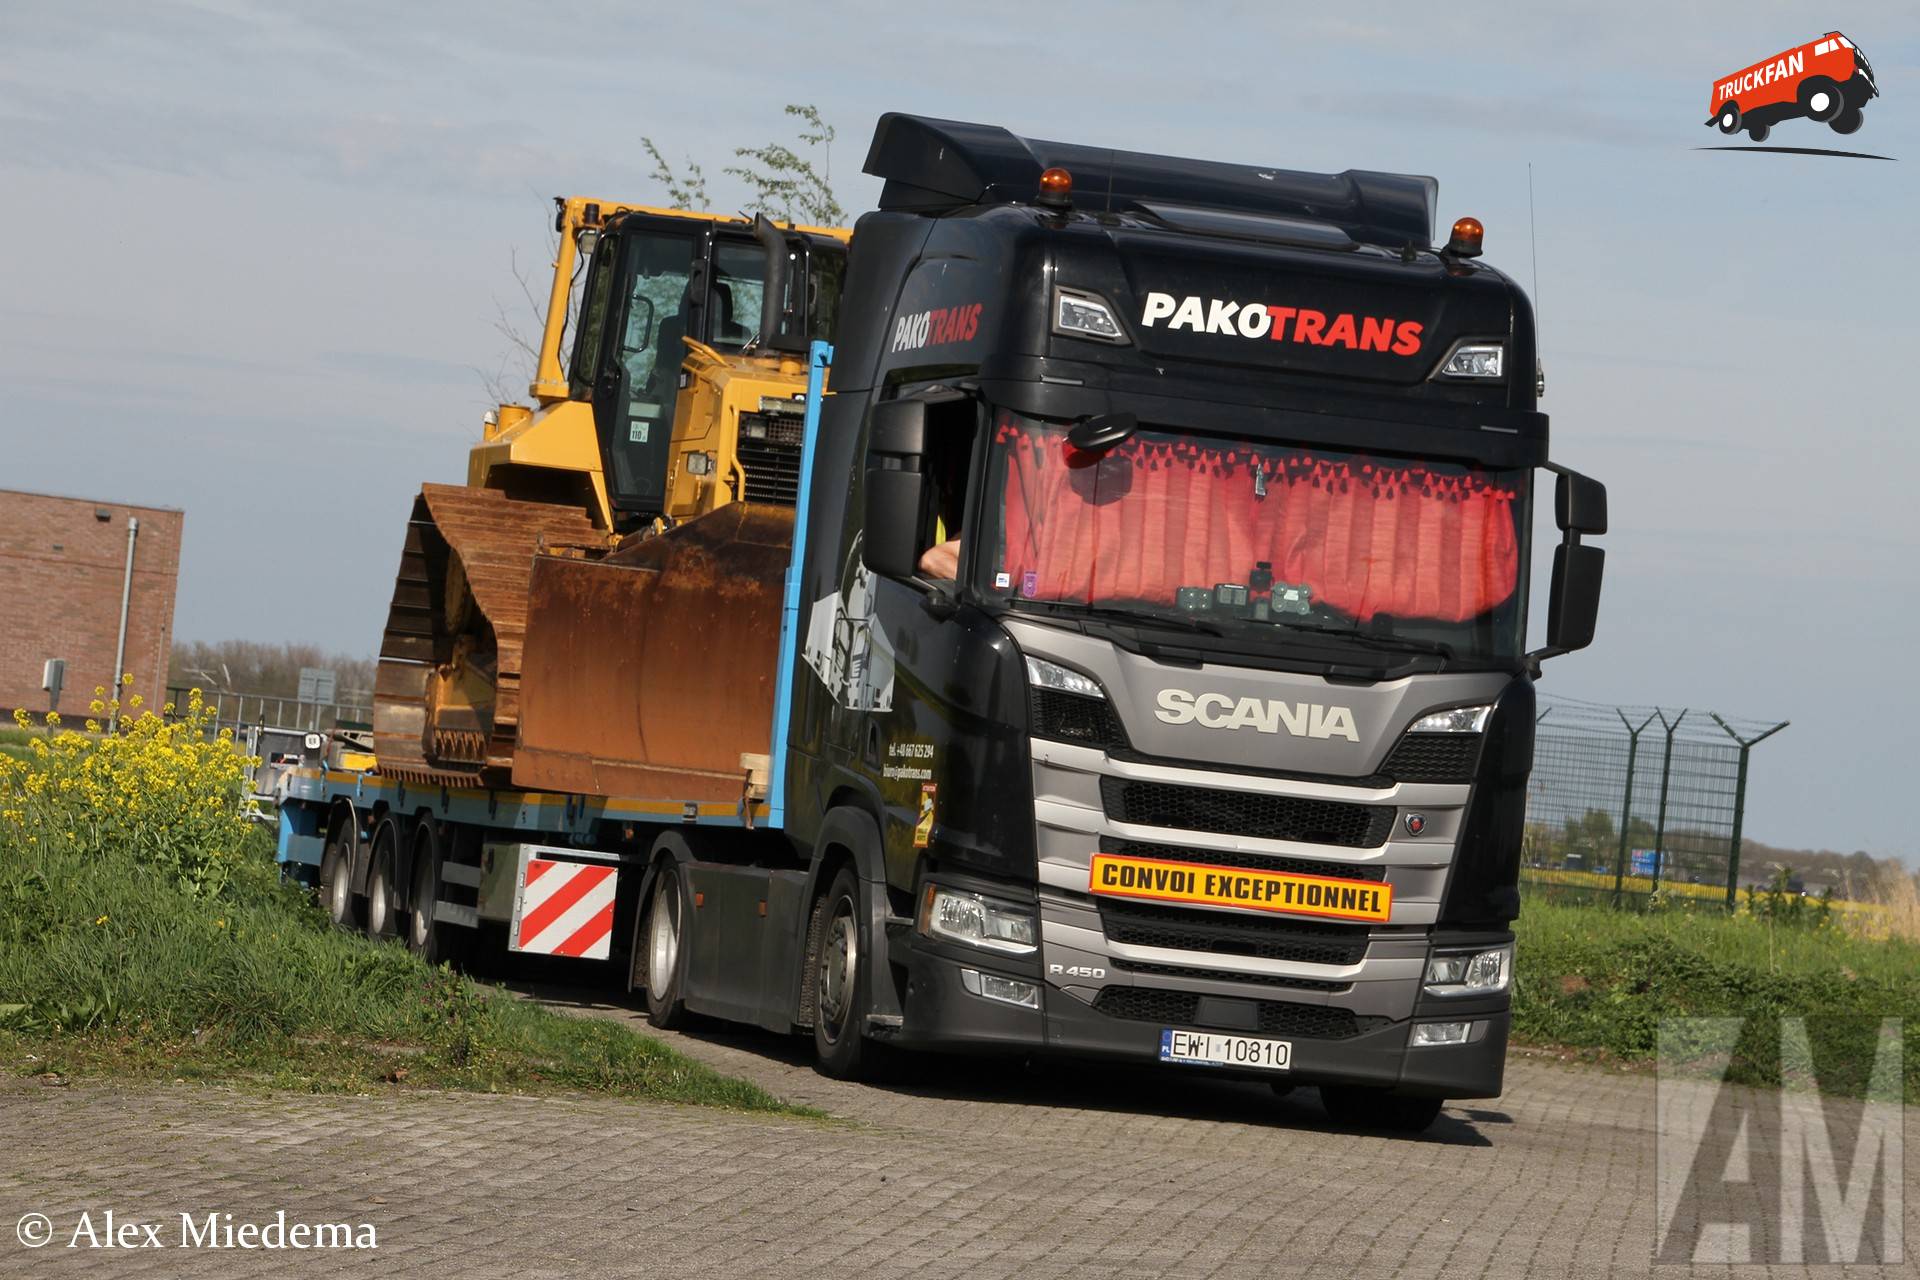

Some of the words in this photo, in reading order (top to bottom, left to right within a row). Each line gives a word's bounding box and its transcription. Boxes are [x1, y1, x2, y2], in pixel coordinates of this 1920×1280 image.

[891, 303, 983, 353] PAKOTRANS
[1141, 292, 1424, 356] PAKOTRANS
[1154, 688, 1360, 742] SCANIA
[1102, 863, 1195, 893] CONVOI
[1205, 874, 1381, 913] EXCEPTIONNEL
[1049, 964, 1064, 976] R
[1065, 966, 1106, 979] 450
[1161, 1045, 1170, 1054] PL
[1224, 1038, 1288, 1066] 10810
